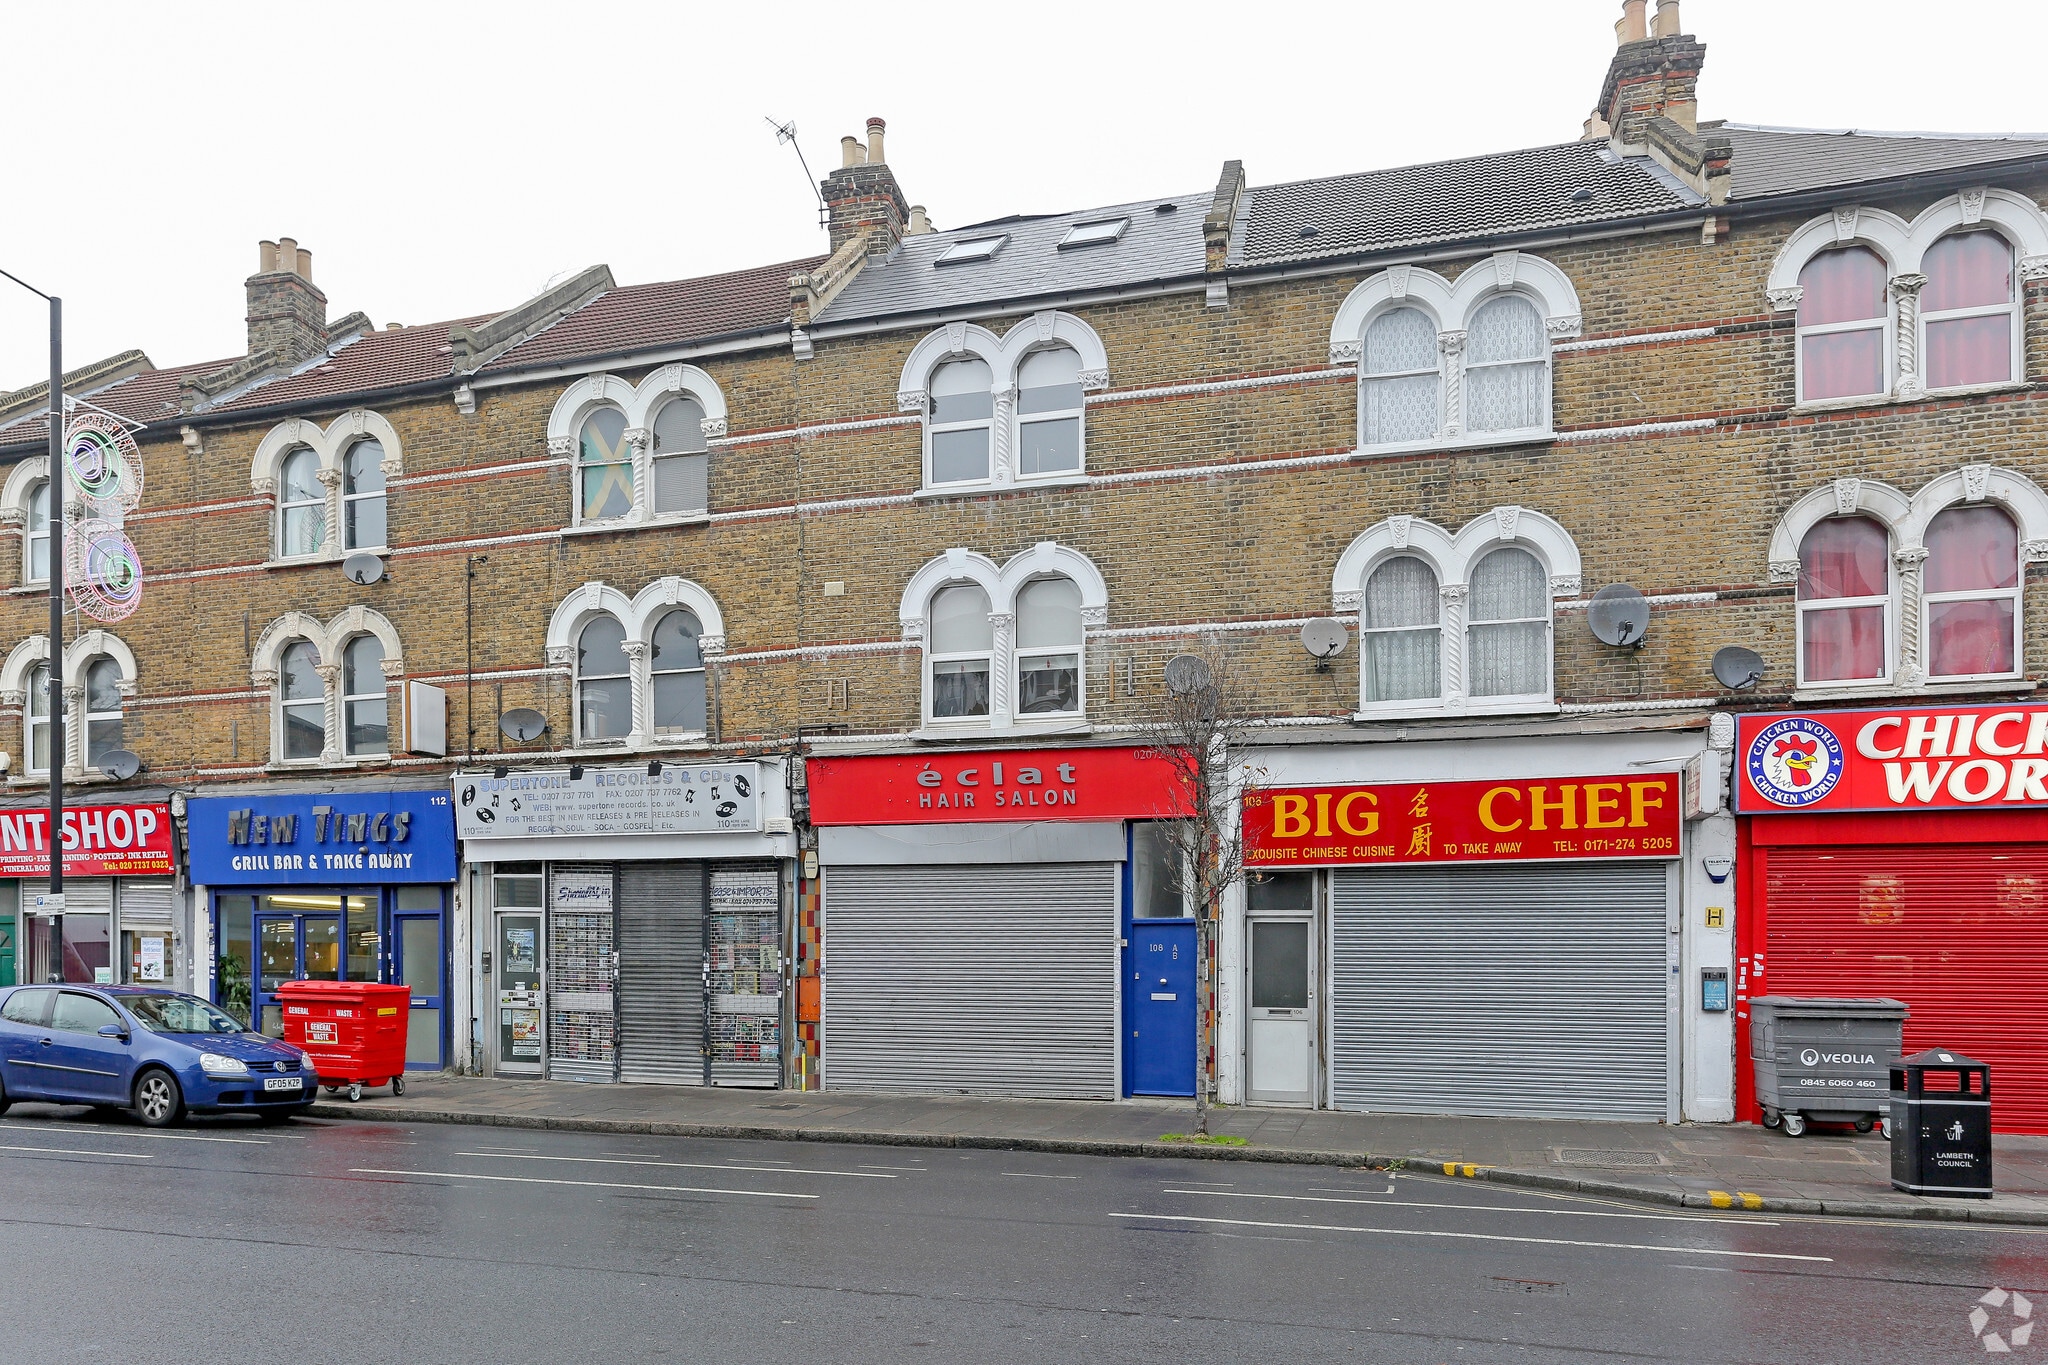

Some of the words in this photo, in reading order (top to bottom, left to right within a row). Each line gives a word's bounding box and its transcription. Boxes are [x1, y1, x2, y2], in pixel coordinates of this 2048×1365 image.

[1753, 721, 1798, 755] CHICKEN
[1804, 721, 1839, 753] WORLD
[916, 762, 1076, 787] éclat
[480, 776, 571, 792] SUPERTONE
[595, 771, 674, 787] RECORDS
[681, 771, 691, 784] &
[700, 770, 731, 783] CDs
[1755, 775, 1798, 803] CHICKEN
[1801, 773, 1837, 801] WORLD
[523, 793, 539, 801] TEL:
[541, 792, 560, 800] 0207
[562, 792, 575, 800] 737
[605, 790, 622, 798] FAX:
[625, 789, 644, 797] 0207
[647, 789, 660, 797] 737
[663, 788, 682, 796] 7762
[919, 793, 975, 808] HAIR
[995, 789, 1077, 807] SALON
[431, 797, 446, 805] 112
[533, 804, 552, 812] WEB:
[578, 802, 615, 811] supertone
[1272, 791, 1379, 838] BIG
[1478, 781, 1668, 833] CHEF
[505, 815, 520, 823] FOR
[568, 813, 584, 821] NEW
[587, 812, 623, 820] RELEASES
[626, 812, 631, 820] &
[634, 811, 648, 819] PRE
[652, 810, 690, 818] RELEASES
[692, 810, 700, 818] IN
[566, 824, 585, 832] SOUL
[594, 823, 614, 831] SOCA
[623, 822, 653, 830] GOSPEL
[717, 820, 730, 828] 110
[62, 809, 157, 851] SHOP
[463, 827, 475, 835] 110
[1443, 844, 1458, 855] TO
[1462, 843, 1489, 854] TAKE
[1494, 842, 1523, 854] AWAY
[1553, 840, 1578, 852] TEL:
[1584, 838, 1636, 851] 0171-274
[1642, 837, 1673, 849] 5205
[0, 855, 34, 863] PRINTING
[93, 852, 124, 861] POSTERS
[127, 851, 141, 859] INK
[142, 851, 168, 859] REFILL
[1303, 847, 1348, 858] CHINESE
[1353, 845, 1395, 857] CUISINE
[103, 862, 118, 870] Tel:
[119, 861, 132, 869] 020
[133, 861, 150, 869] 7737
[151, 860, 169, 868] 0323
[232, 855, 270, 871] GRILL
[274, 855, 302, 870] BAR
[309, 855, 318, 869] &
[324, 853, 363, 869] TAKE
[368, 853, 413, 869] AWAY
[1149, 943, 1164, 952] 108
[1172, 952, 1178, 960] B
[288, 1006, 309, 1015] GENERAL
[336, 1009, 353, 1018] WASTE
[310, 1022, 332, 1032] GENERAL
[313, 1033, 329, 1041] WASTE
[1821, 1053, 1876, 1064] VEOLIA
[267, 1079, 287, 1089] GF05
[288, 1078, 300, 1087] KZP
[1800, 1079, 1826, 1087] 0845
[1828, 1079, 1854, 1087] 6060
[1936, 1152, 1974, 1160] LAMBETH
[1937, 1160, 1972, 1168] COUNCIL
